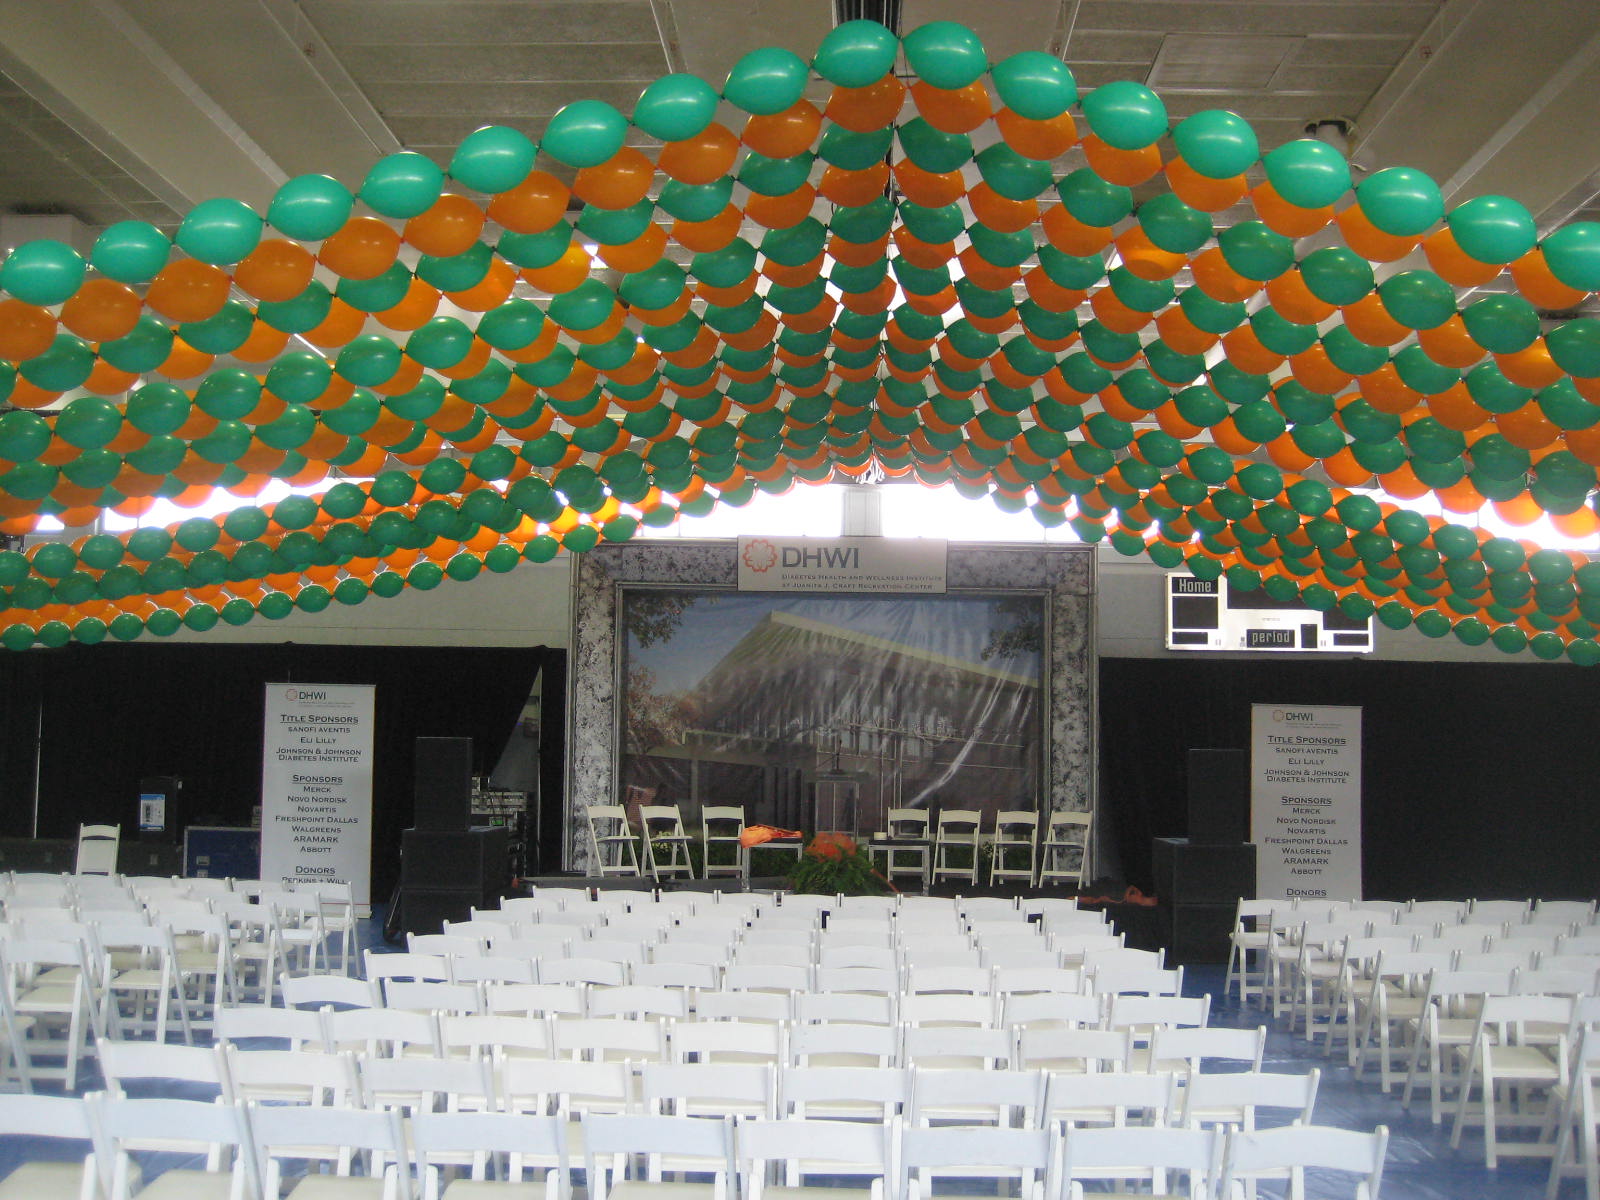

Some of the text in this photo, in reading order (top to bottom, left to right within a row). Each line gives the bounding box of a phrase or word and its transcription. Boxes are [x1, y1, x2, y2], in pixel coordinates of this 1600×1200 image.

[781, 547, 859, 569] DHWI
[1179, 578, 1212, 593] Home
[1252, 630, 1290, 645] period
[299, 692, 326, 700] DHWI
[280, 714, 359, 723] TITLE SPONSORS
[1285, 712, 1313, 721] DHWI
[1267, 735, 1347, 744] TITLE SPONSORS
[275, 747, 314, 755] JOHNSON
[319, 755, 359, 763] INSTITUTE
[292, 775, 343, 783] SPONSORS
[1307, 776, 1347, 784] INSTITUTE
[311, 796, 348, 804] NORDISK
[1281, 796, 1332, 805] SPONSORS
[1292, 807, 1321, 815] MERCK
[275, 815, 359, 824] FRESHPOINT DALLAS
[1287, 827, 1326, 835] NOVARTIS
[293, 835, 339, 843] ARAMARK
[1281, 847, 1332, 855] WALGREENS
[1283, 857, 1329, 865] ARAMARK
[295, 866, 336, 874] DONORS
[1286, 888, 1327, 896] DONORS
